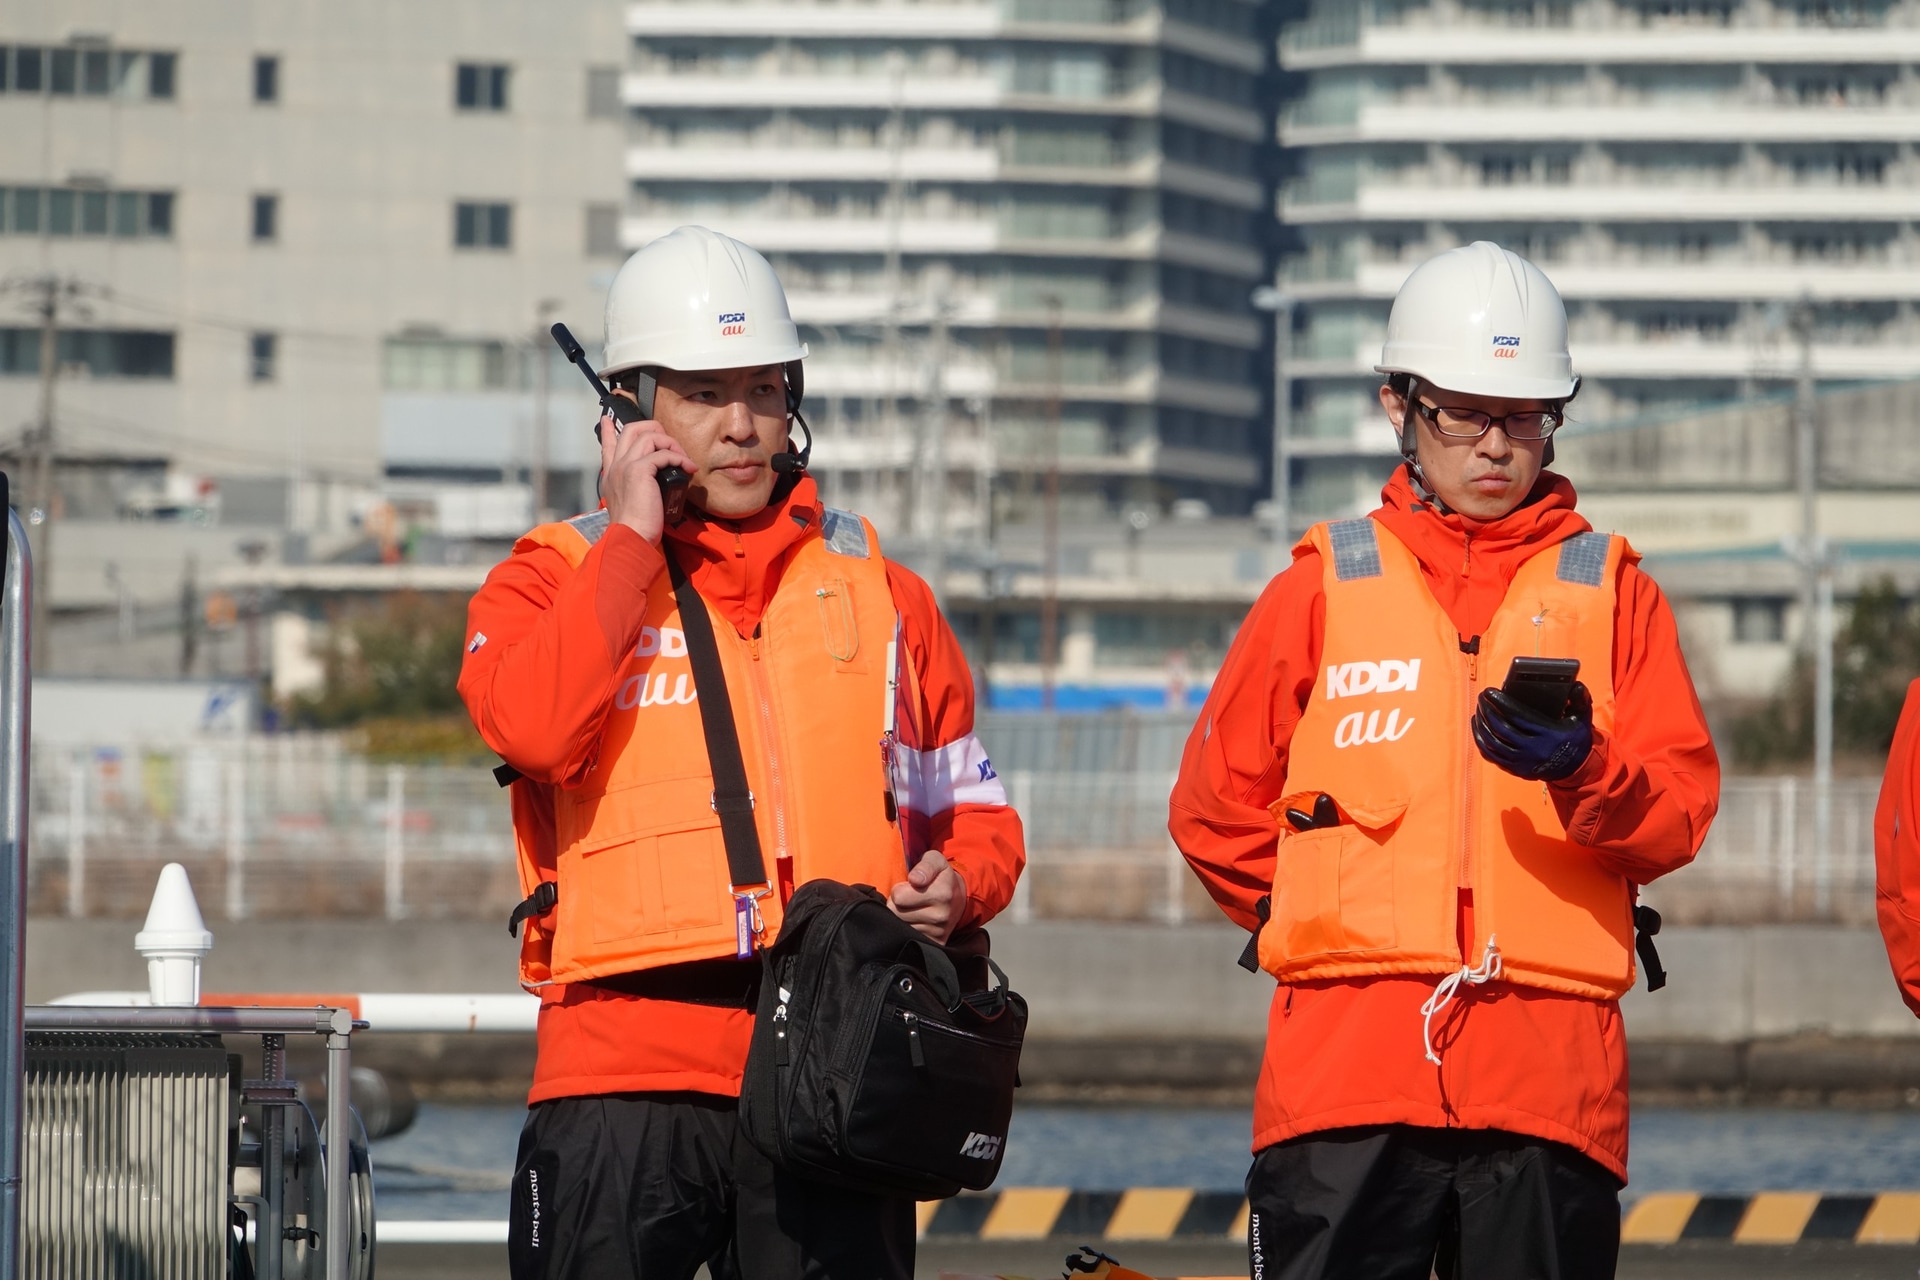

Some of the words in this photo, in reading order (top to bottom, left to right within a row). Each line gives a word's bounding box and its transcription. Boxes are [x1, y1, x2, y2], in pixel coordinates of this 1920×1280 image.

[719, 312, 745, 324] KDDI
[722, 325, 746, 336] au
[1492, 336, 1520, 346] KDDI
[1494, 348, 1518, 358] au
[634, 625, 688, 658] DD
[615, 672, 698, 710] au
[1326, 658, 1421, 701] KDDI
[1333, 707, 1416, 749] au
[959, 1131, 1001, 1160] KDDI
